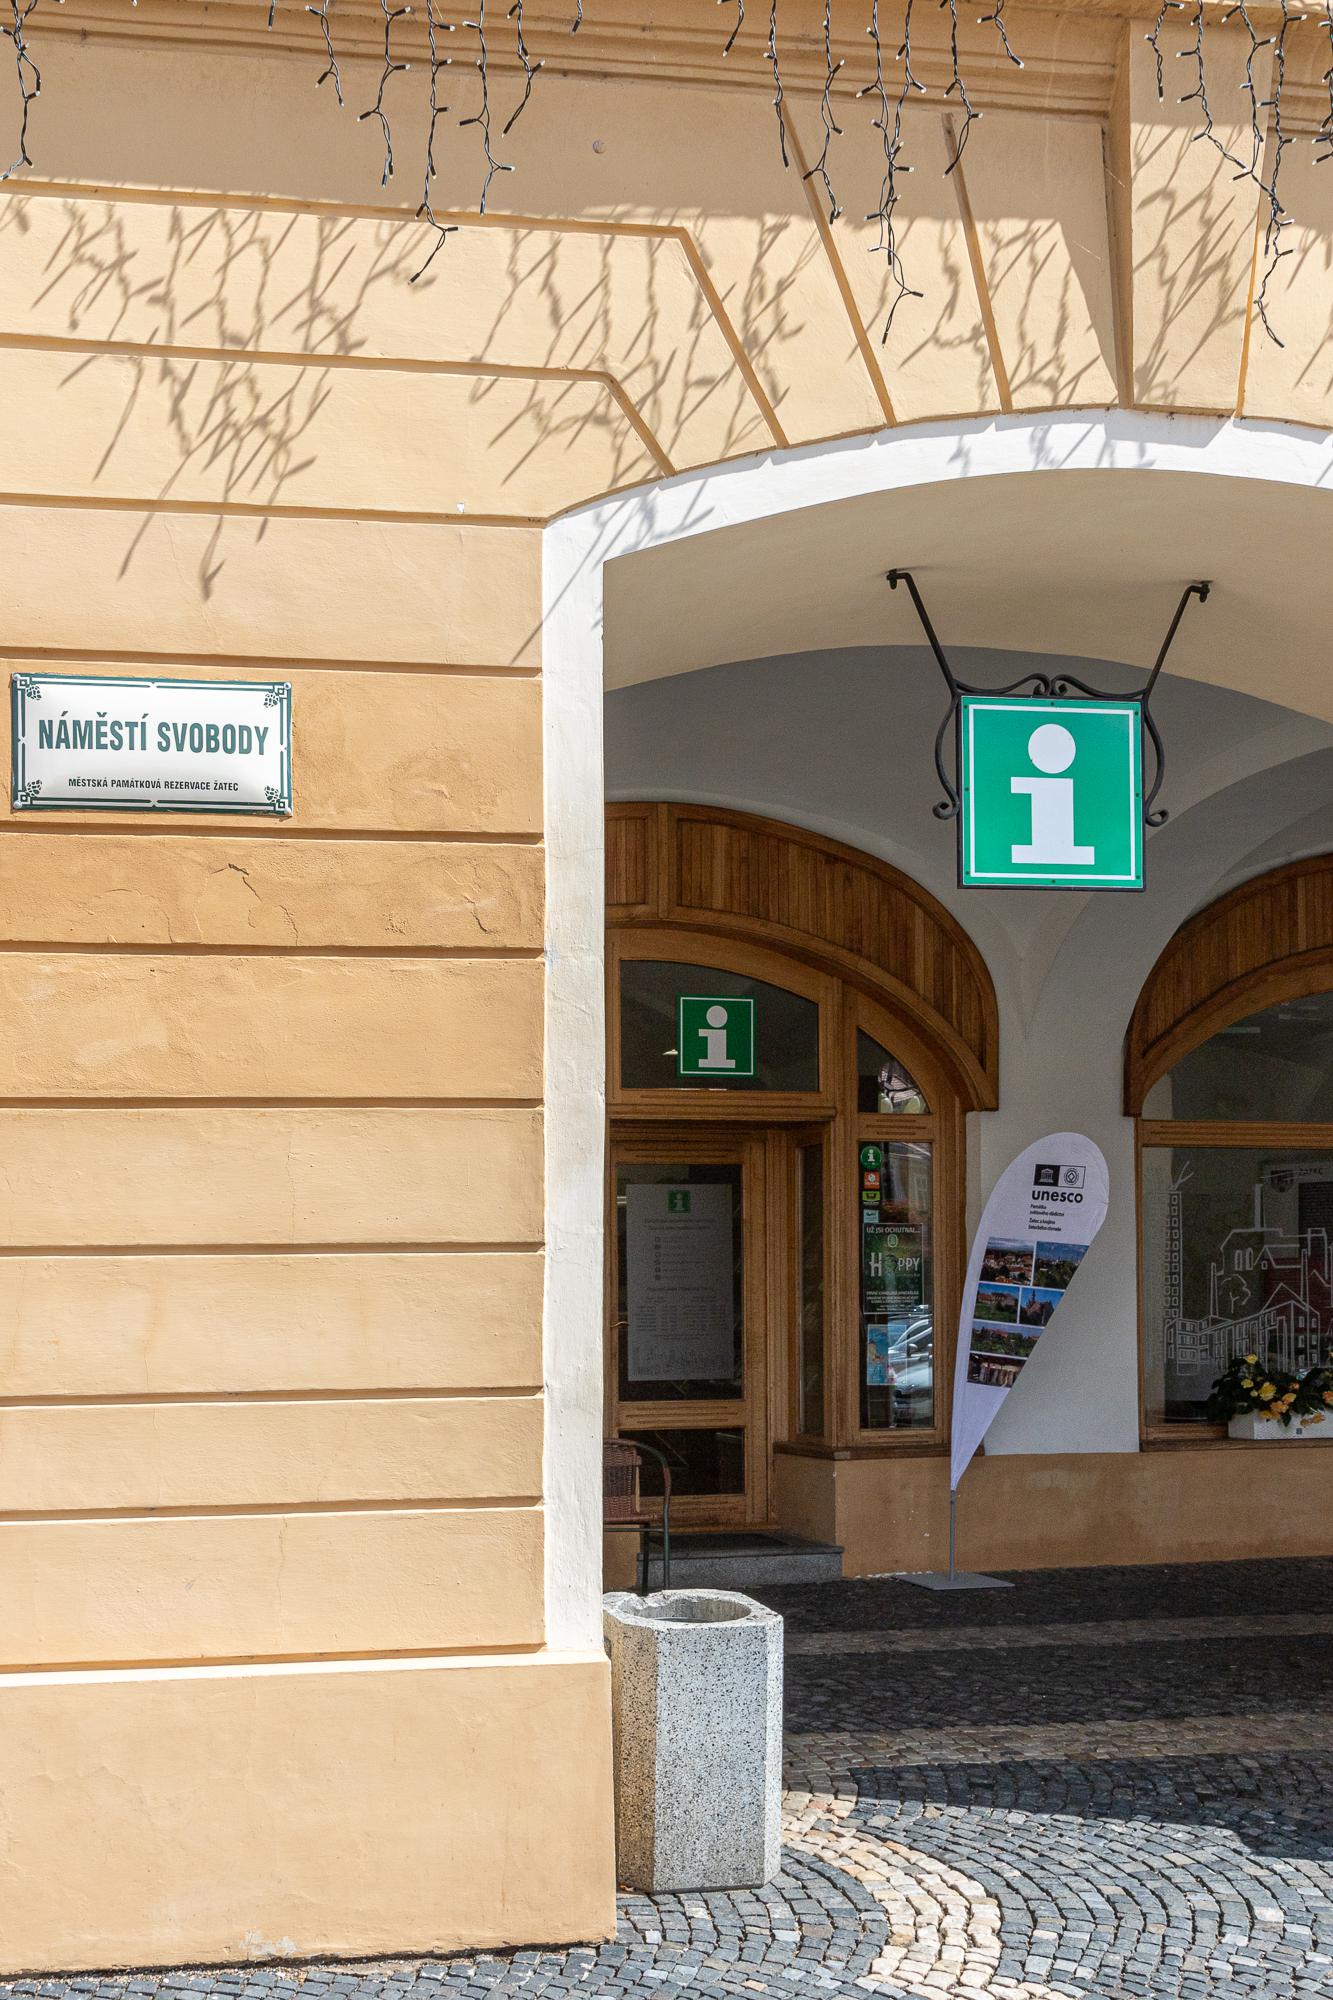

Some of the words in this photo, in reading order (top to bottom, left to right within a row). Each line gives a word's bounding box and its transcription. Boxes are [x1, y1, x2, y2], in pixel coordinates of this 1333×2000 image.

[38, 710, 149, 751] NÁMĚSTÍ
[157, 722, 269, 755] SVOBODY
[68, 776, 108, 788] MĚSTSKÁ
[110, 777, 161, 789] PAMÁTKOVÁ
[164, 780, 211, 791] REZERVACE
[213, 779, 239, 791] ŽATEC
[1032, 1190, 1083, 1203] unesco
